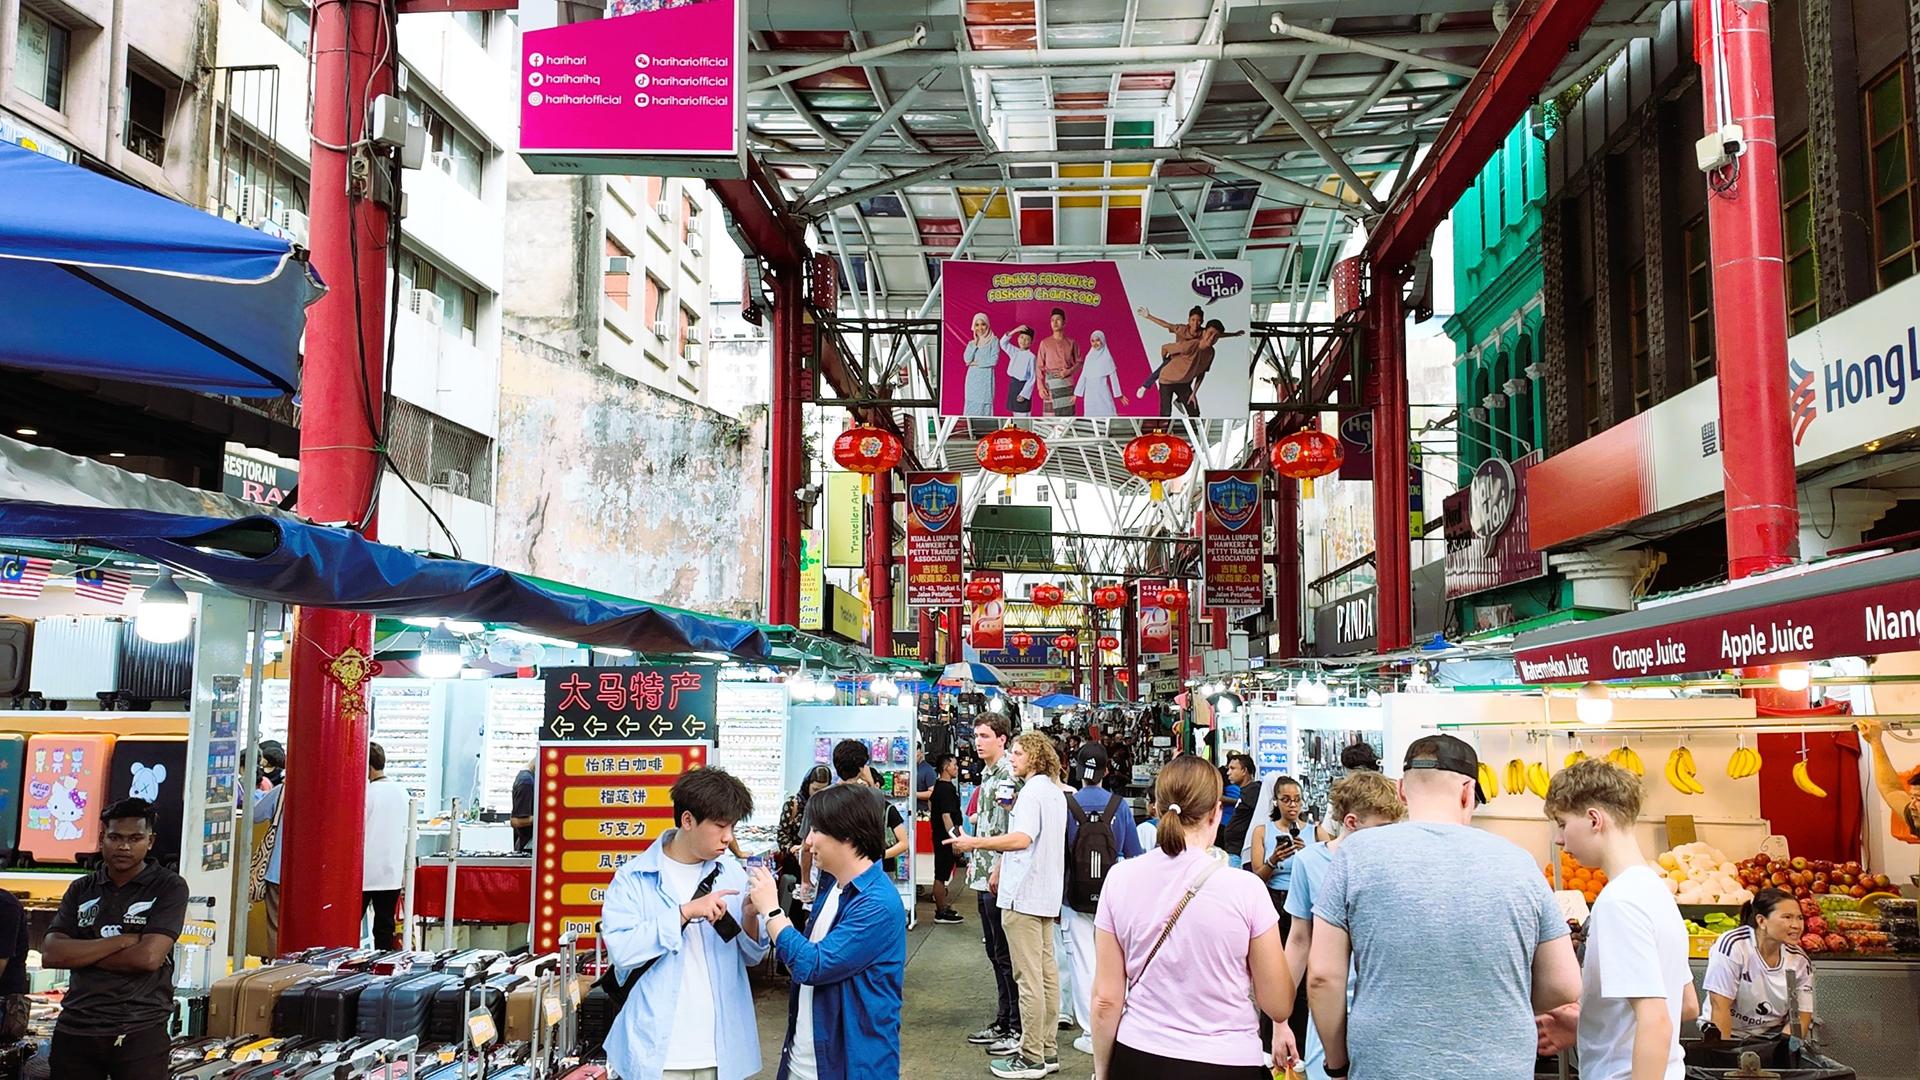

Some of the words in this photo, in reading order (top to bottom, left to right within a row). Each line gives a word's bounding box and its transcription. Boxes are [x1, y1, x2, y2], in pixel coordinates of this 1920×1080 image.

[546, 55, 587, 65] harihari
[652, 56, 728, 67] harihariofficial
[546, 74, 601, 85] hariharihq
[651, 76, 728, 86] harihariofficial
[545, 95, 622, 105] harihariofficial
[651, 96, 728, 106] harihariofficial
[1196, 273, 1223, 287] Hari
[1211, 283, 1238, 297] Hari
[1348, 417, 1371, 432] Ha
[223, 453, 277, 486] RESTORAN
[242, 480, 290, 505] RA
[850, 485, 859, 504] Ark
[1484, 489, 1507, 535] Hari
[850, 506, 859, 554] Traveller
[1336, 593, 1373, 643] PANDA
[1720, 624, 1767, 661] Apple
[1769, 619, 1814, 652] Juice
[1612, 643, 1654, 675] Orange
[1655, 637, 1686, 666] Juice
[1520, 655, 1566, 682] Watermelon
[1565, 653, 1589, 676] Juice
[558, 671, 702, 711] 大马特产
[585, 757, 663, 773] 怡保白咖啡
[600, 788, 646, 805] 榴莲饼
[599, 821, 646, 837] 巧克力
[598, 854, 638, 868] 凤梨
[590, 888, 605, 901] CH
